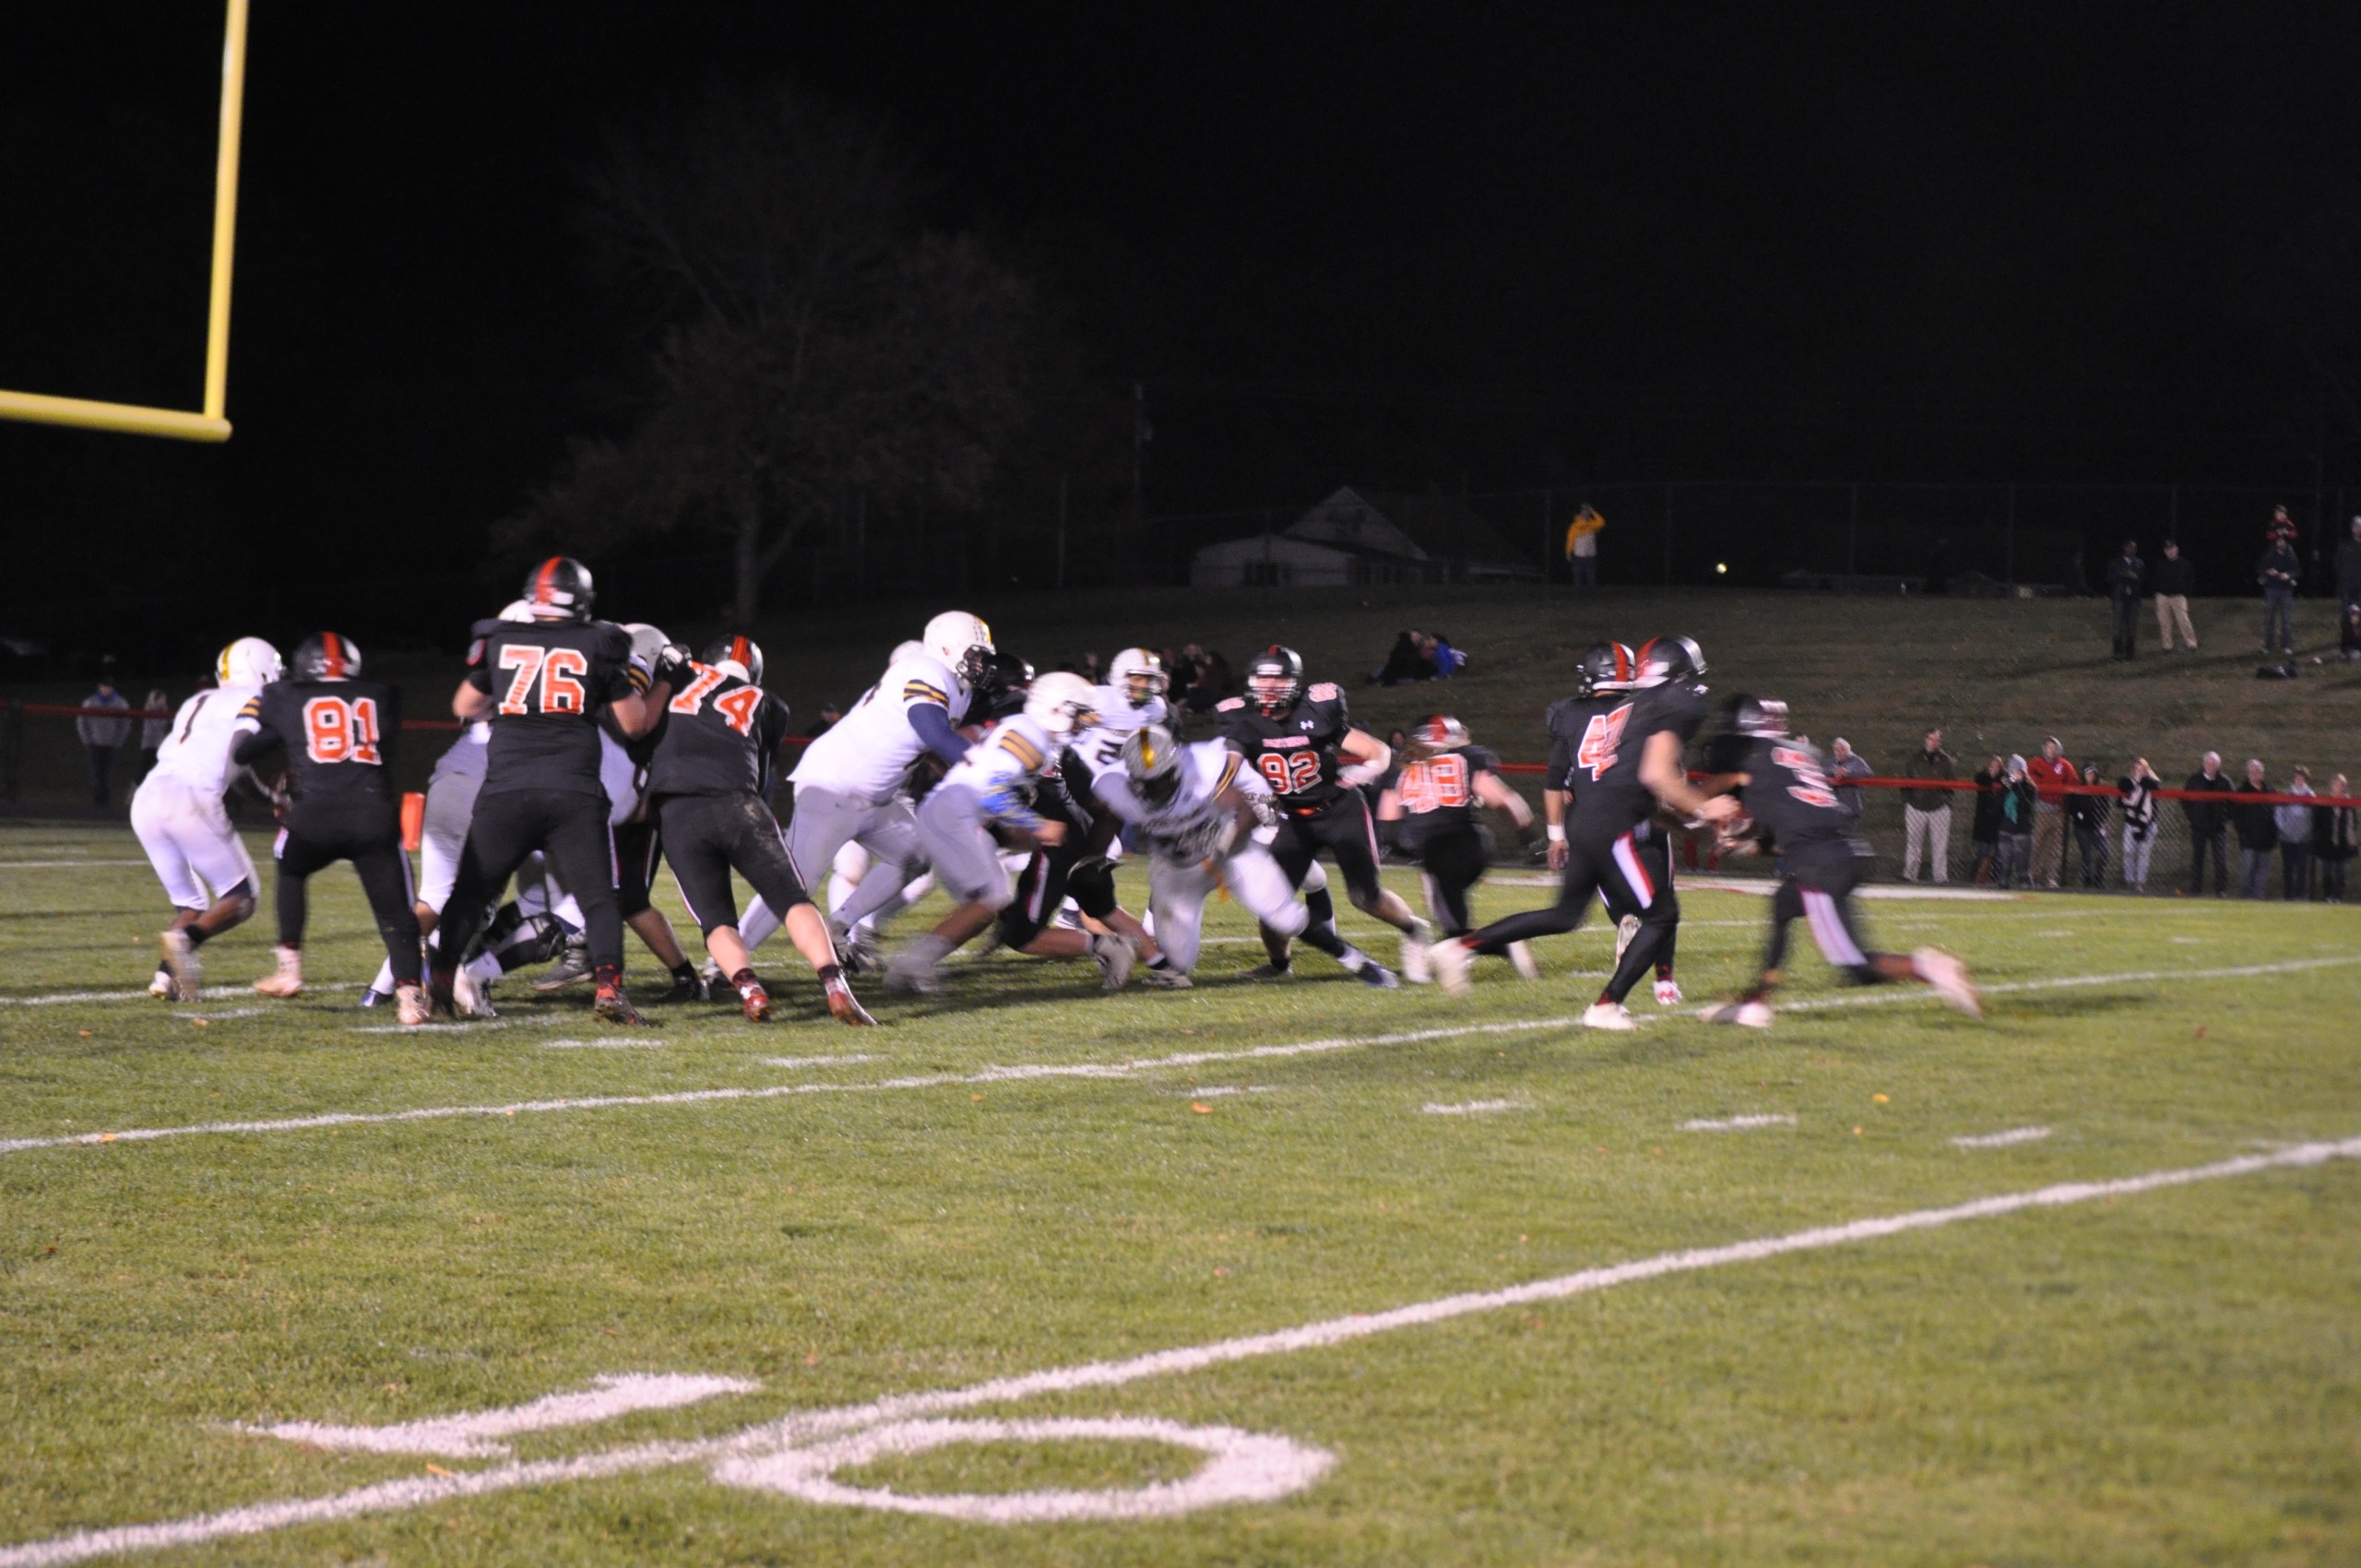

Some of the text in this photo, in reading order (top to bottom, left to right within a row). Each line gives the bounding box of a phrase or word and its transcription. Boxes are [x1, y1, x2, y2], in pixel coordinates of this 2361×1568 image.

[499, 645, 587, 715] 76
[669, 661, 764, 737] 74
[180, 695, 210, 743] 1
[303, 696, 383, 765] 81
[1257, 750, 1323, 795] 92
